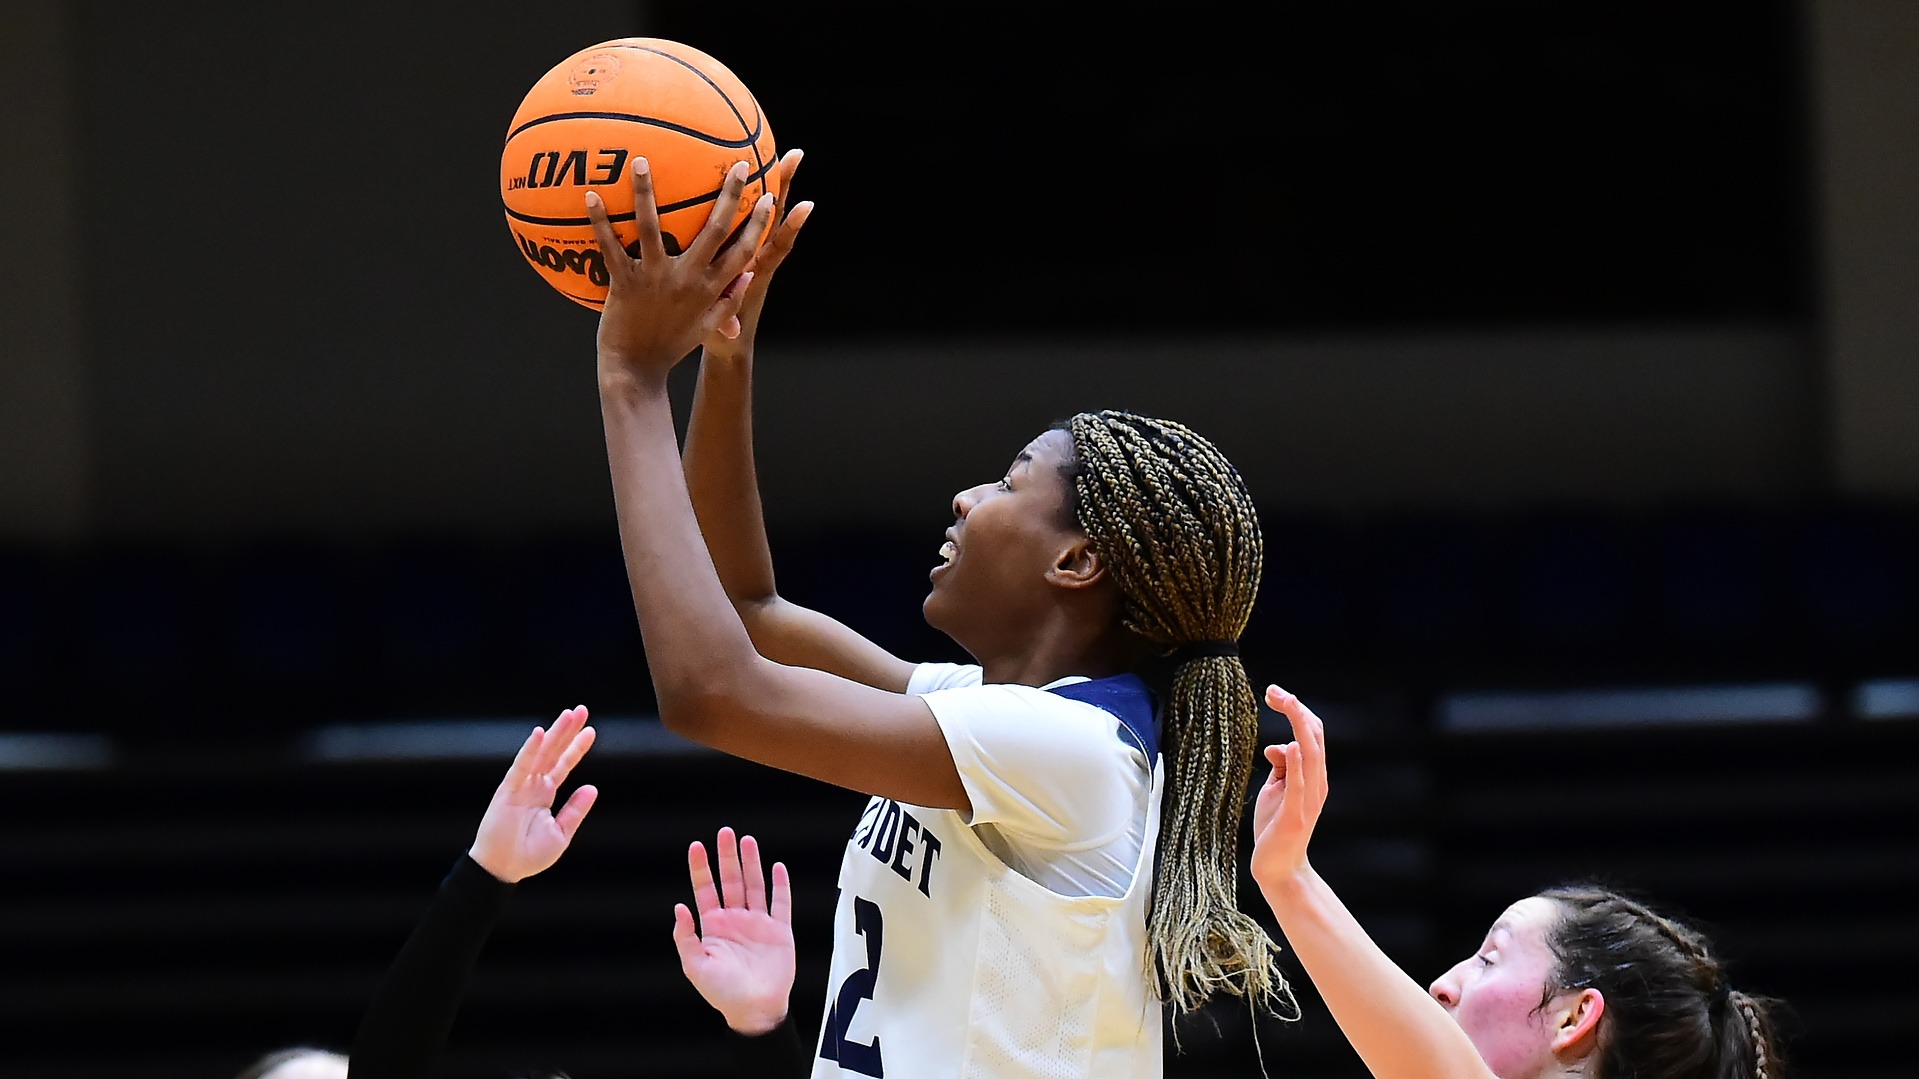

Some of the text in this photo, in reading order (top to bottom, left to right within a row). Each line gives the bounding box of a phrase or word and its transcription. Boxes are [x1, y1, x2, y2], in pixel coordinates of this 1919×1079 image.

[508, 149, 629, 191] EVO NXT
[515, 231, 684, 286] lson
[543, 236, 561, 245] BALL
